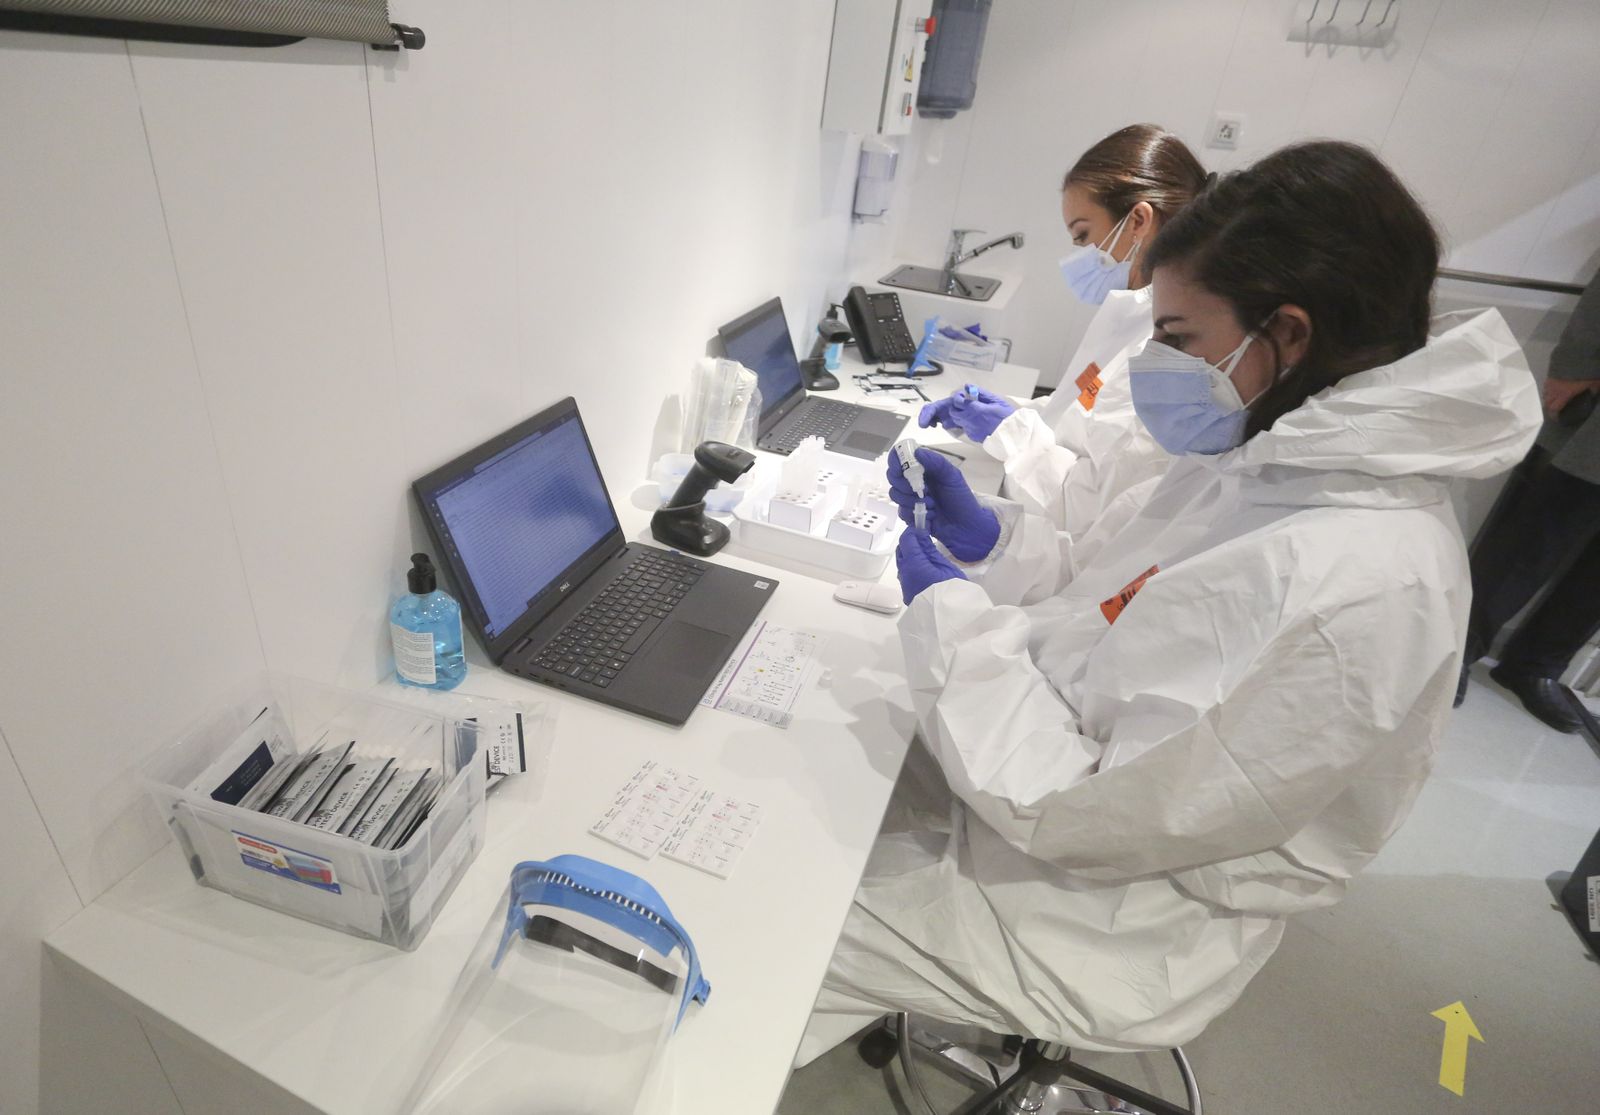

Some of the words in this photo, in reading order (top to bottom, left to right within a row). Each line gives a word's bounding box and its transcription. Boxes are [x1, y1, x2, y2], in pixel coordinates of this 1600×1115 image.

[560, 581, 571, 592] DELL
[493, 745, 501, 765] DEVICE
[328, 792, 348, 812] DEVICE
[368, 804, 387, 823] DEVICE
